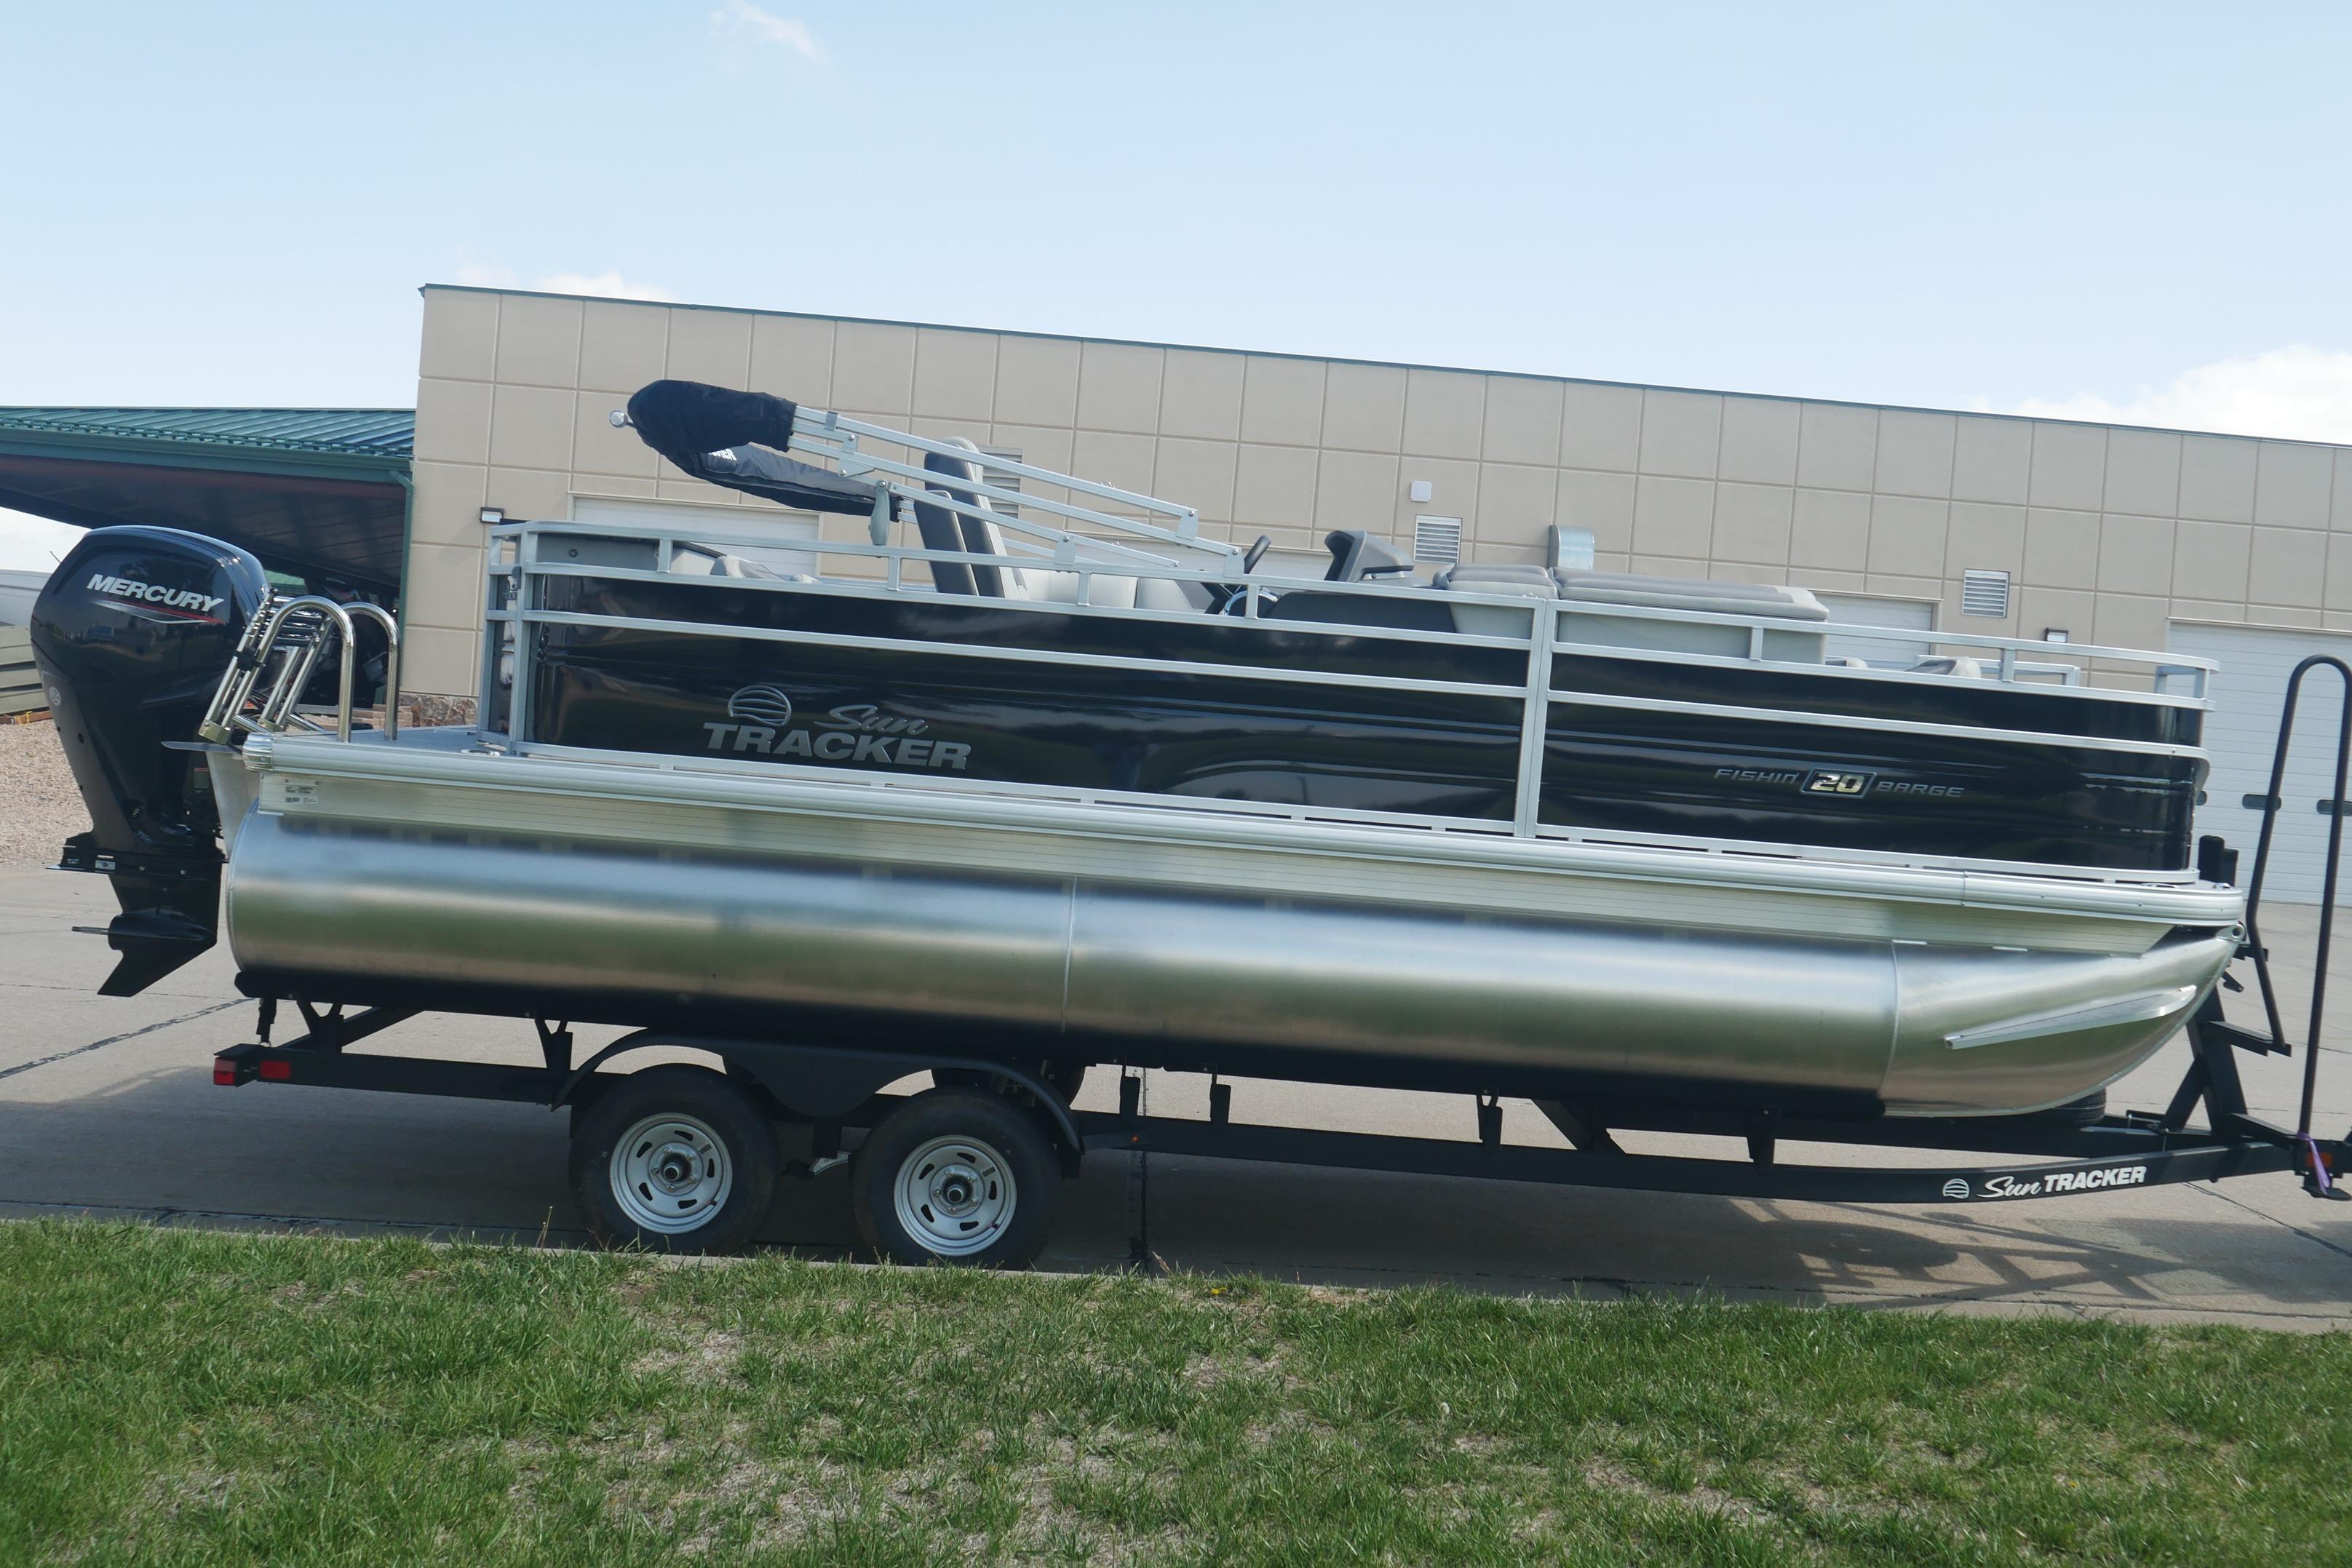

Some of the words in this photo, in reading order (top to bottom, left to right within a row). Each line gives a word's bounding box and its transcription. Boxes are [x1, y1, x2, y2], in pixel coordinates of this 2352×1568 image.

[87, 573, 224, 612] MERCURY
[814, 704, 929, 735] Sun
[703, 722, 972, 769] TRACKER
[1713, 768, 1800, 784] FISHIN
[1811, 772, 1865, 793] 20
[1875, 781, 1965, 797] BARGE
[1976, 1175, 2041, 1198] Sun
[2043, 1166, 2147, 1193] TRACKER
